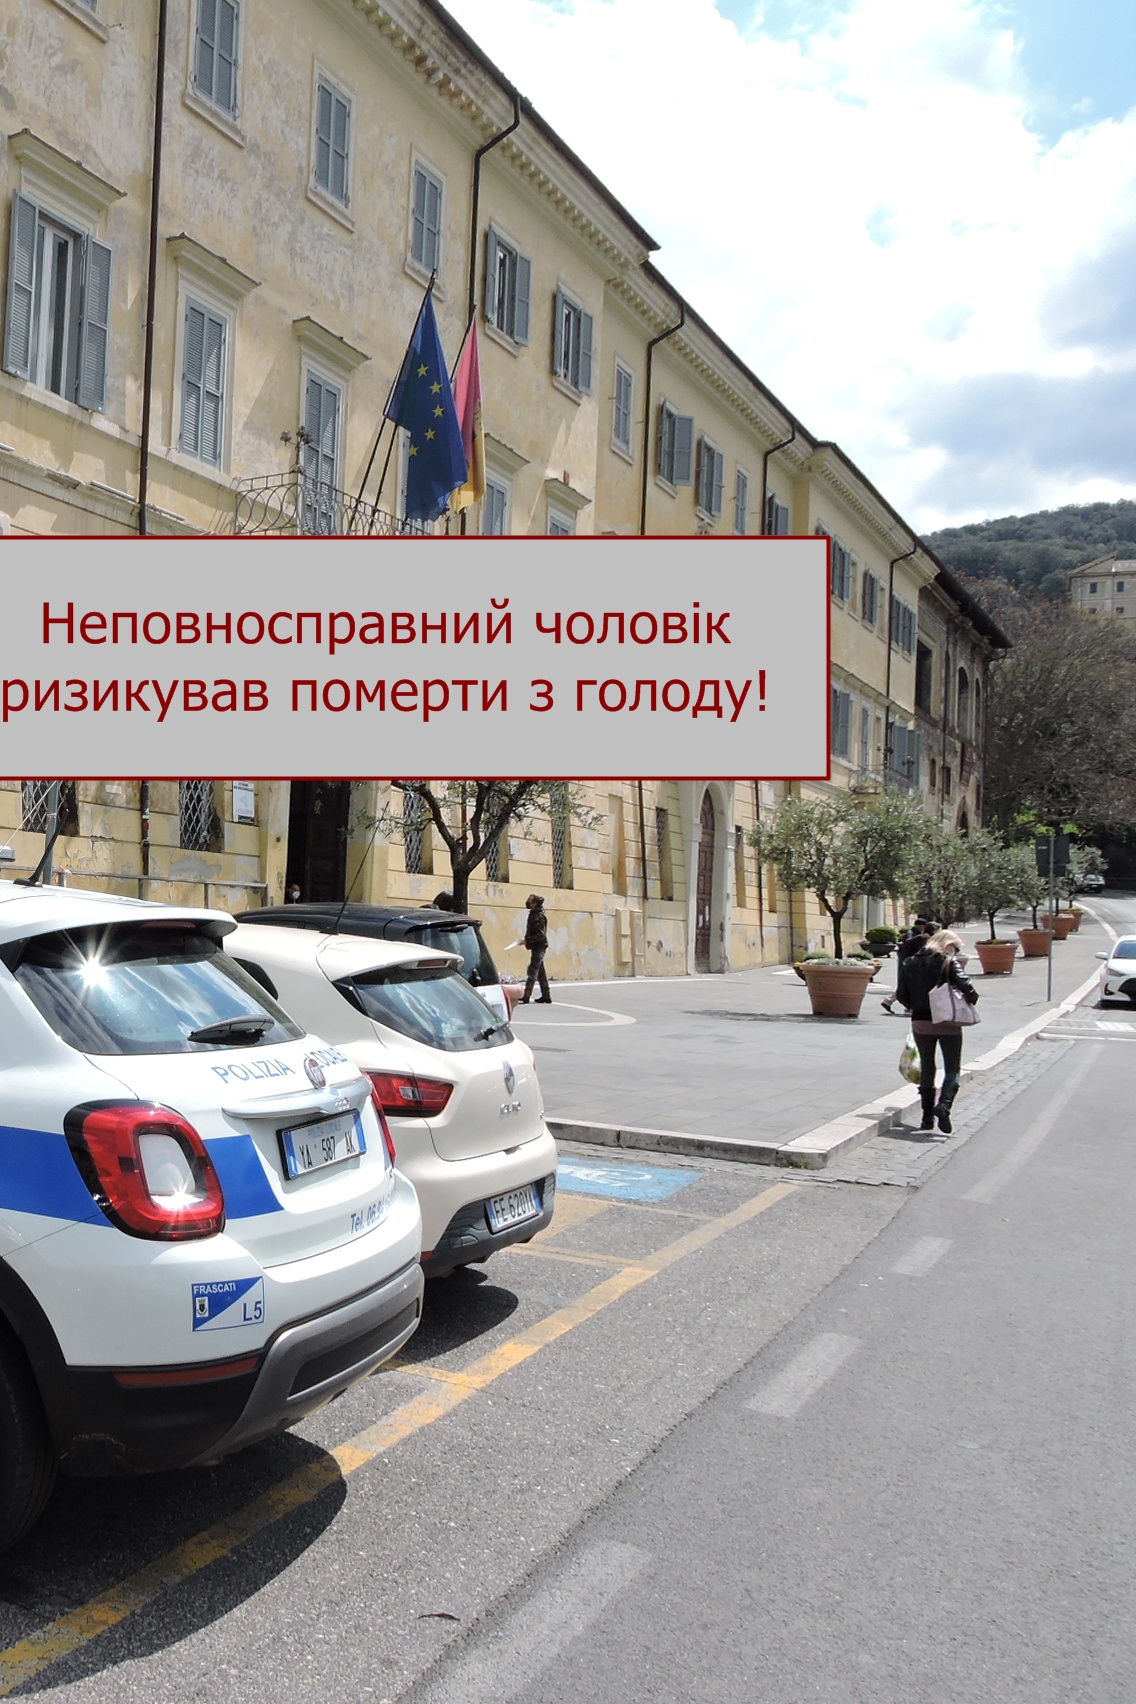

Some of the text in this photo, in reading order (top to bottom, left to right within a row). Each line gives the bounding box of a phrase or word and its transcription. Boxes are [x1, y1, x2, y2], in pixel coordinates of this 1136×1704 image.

[211, 1059, 296, 1083] POLIZIA
[321, 1135, 337, 1162] 587
[193, 1282, 237, 1295] FRASCATI
[243, 1300, 262, 1322] L5
